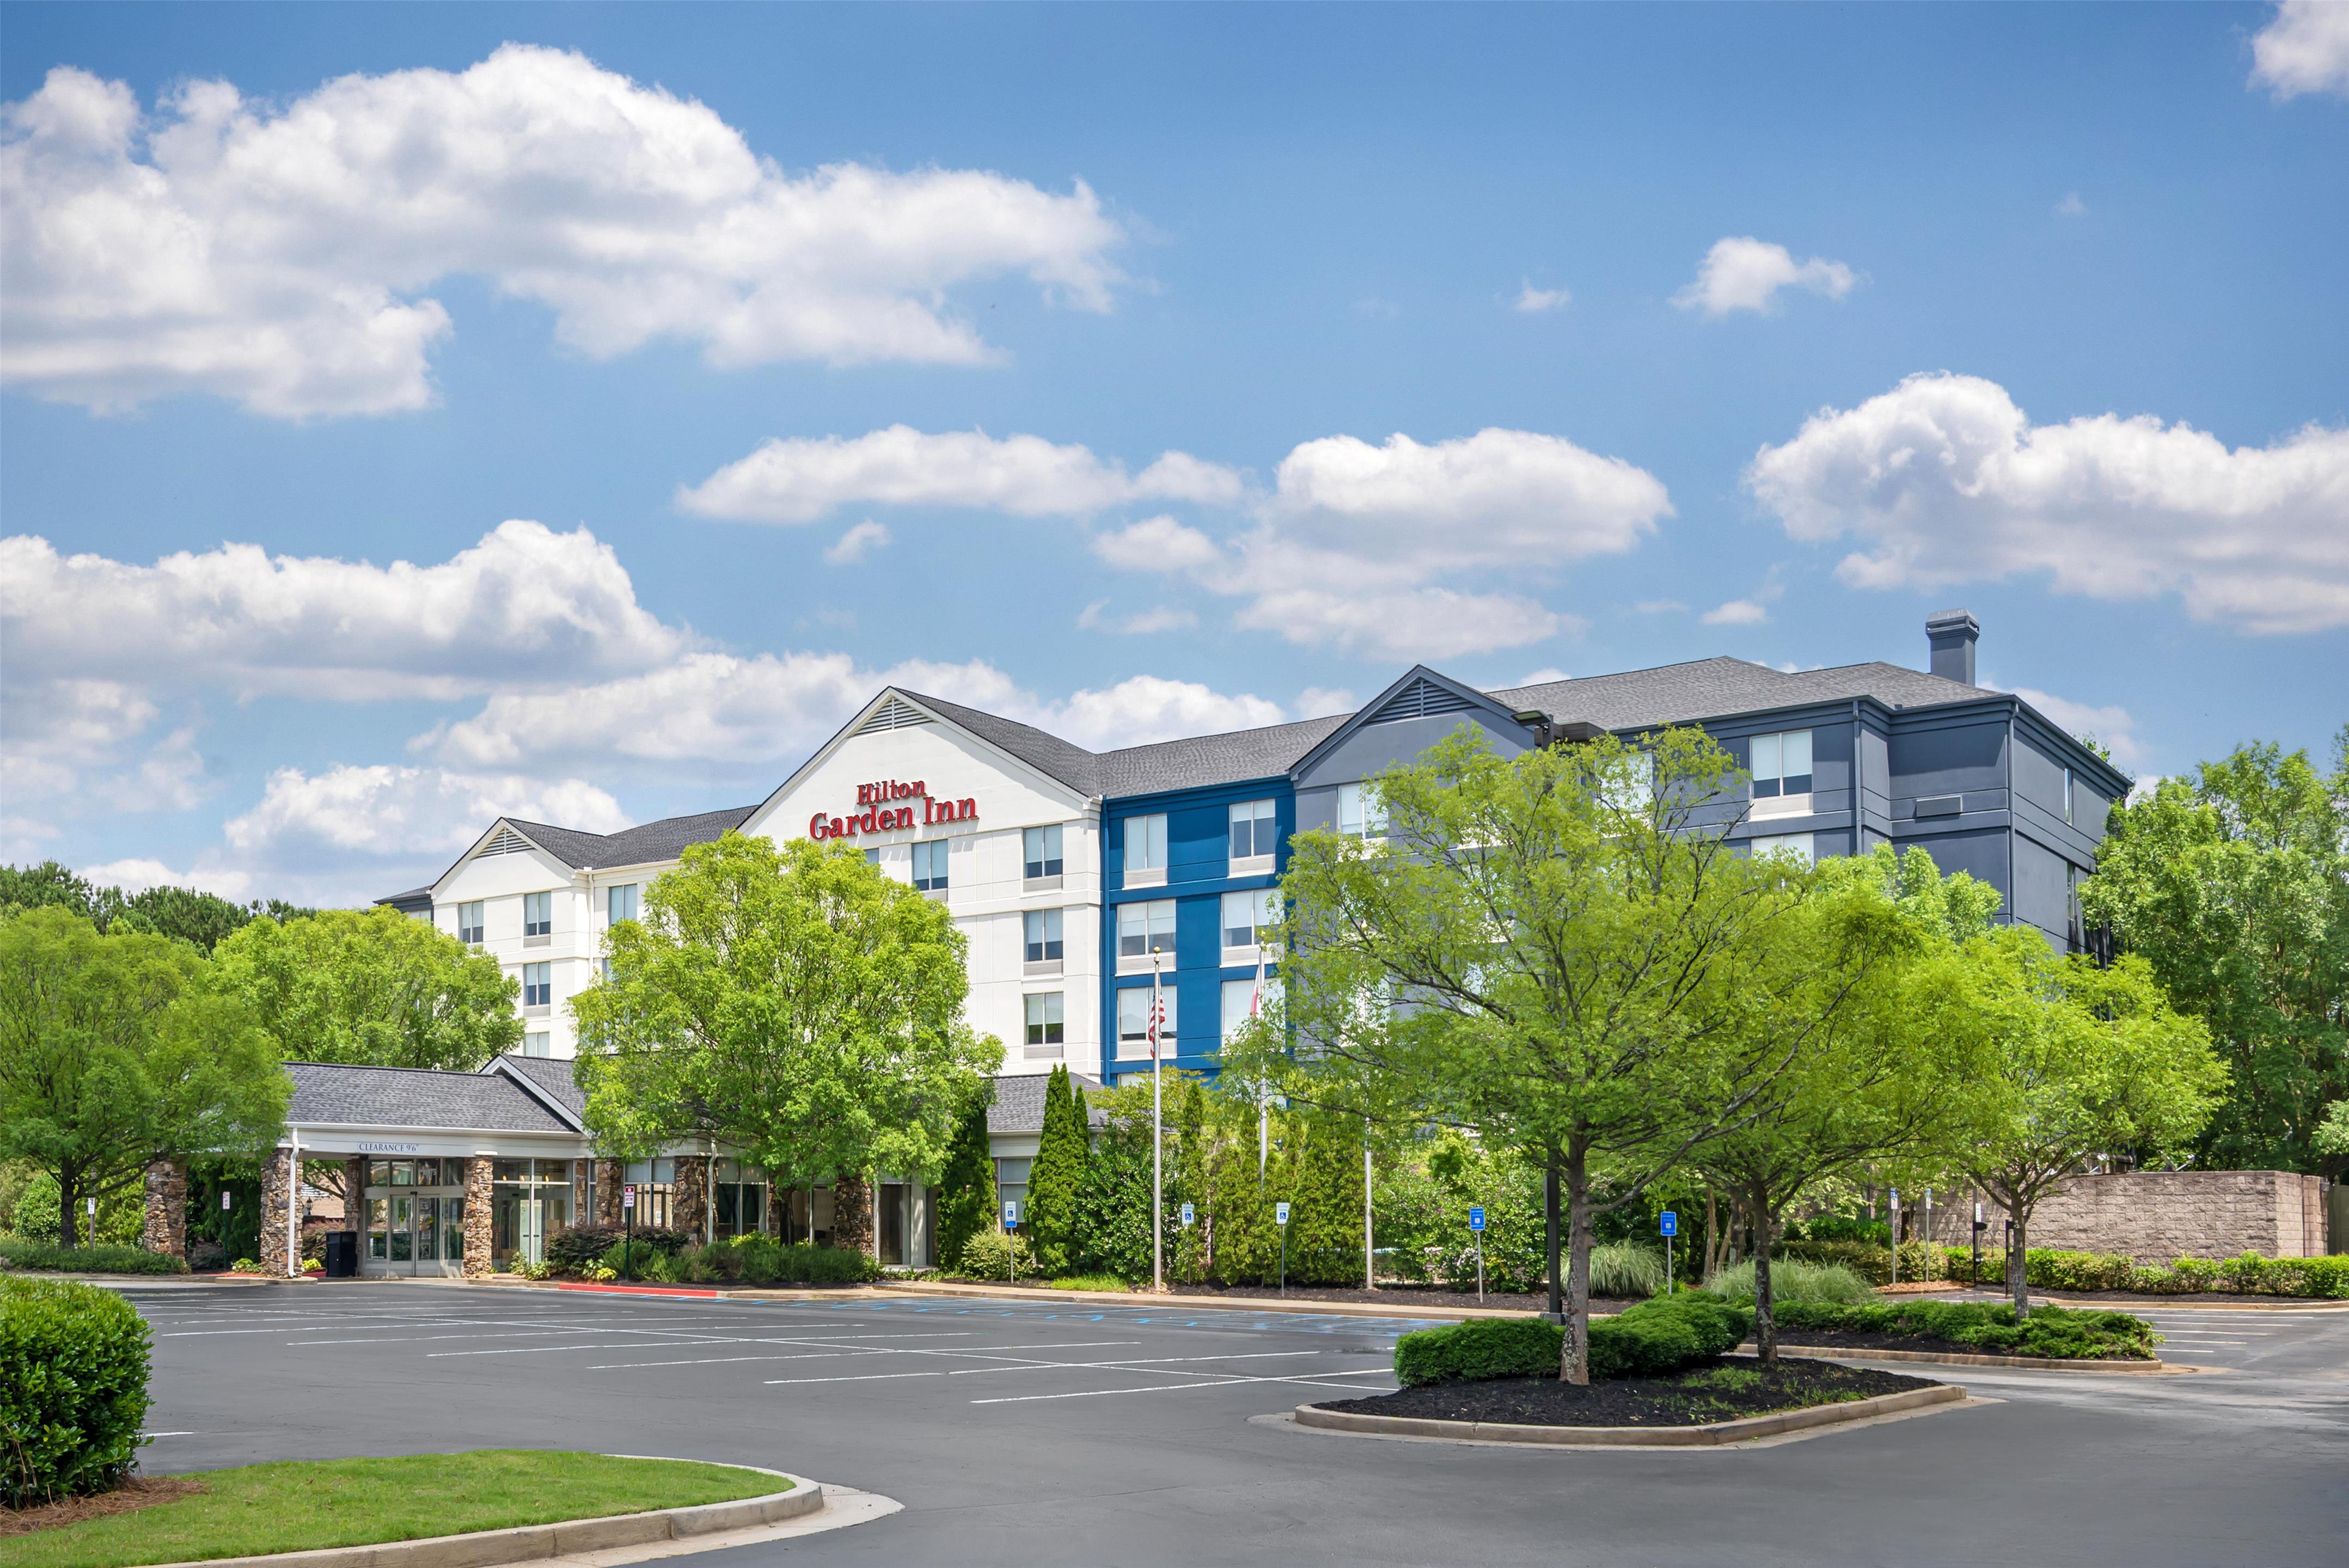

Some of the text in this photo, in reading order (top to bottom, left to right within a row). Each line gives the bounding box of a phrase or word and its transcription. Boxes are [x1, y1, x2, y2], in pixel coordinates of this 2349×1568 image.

[857, 779, 926, 805] Hilton
[810, 796, 980, 840] Garden Inn
[359, 1143, 405, 1152] CLEARANCE
